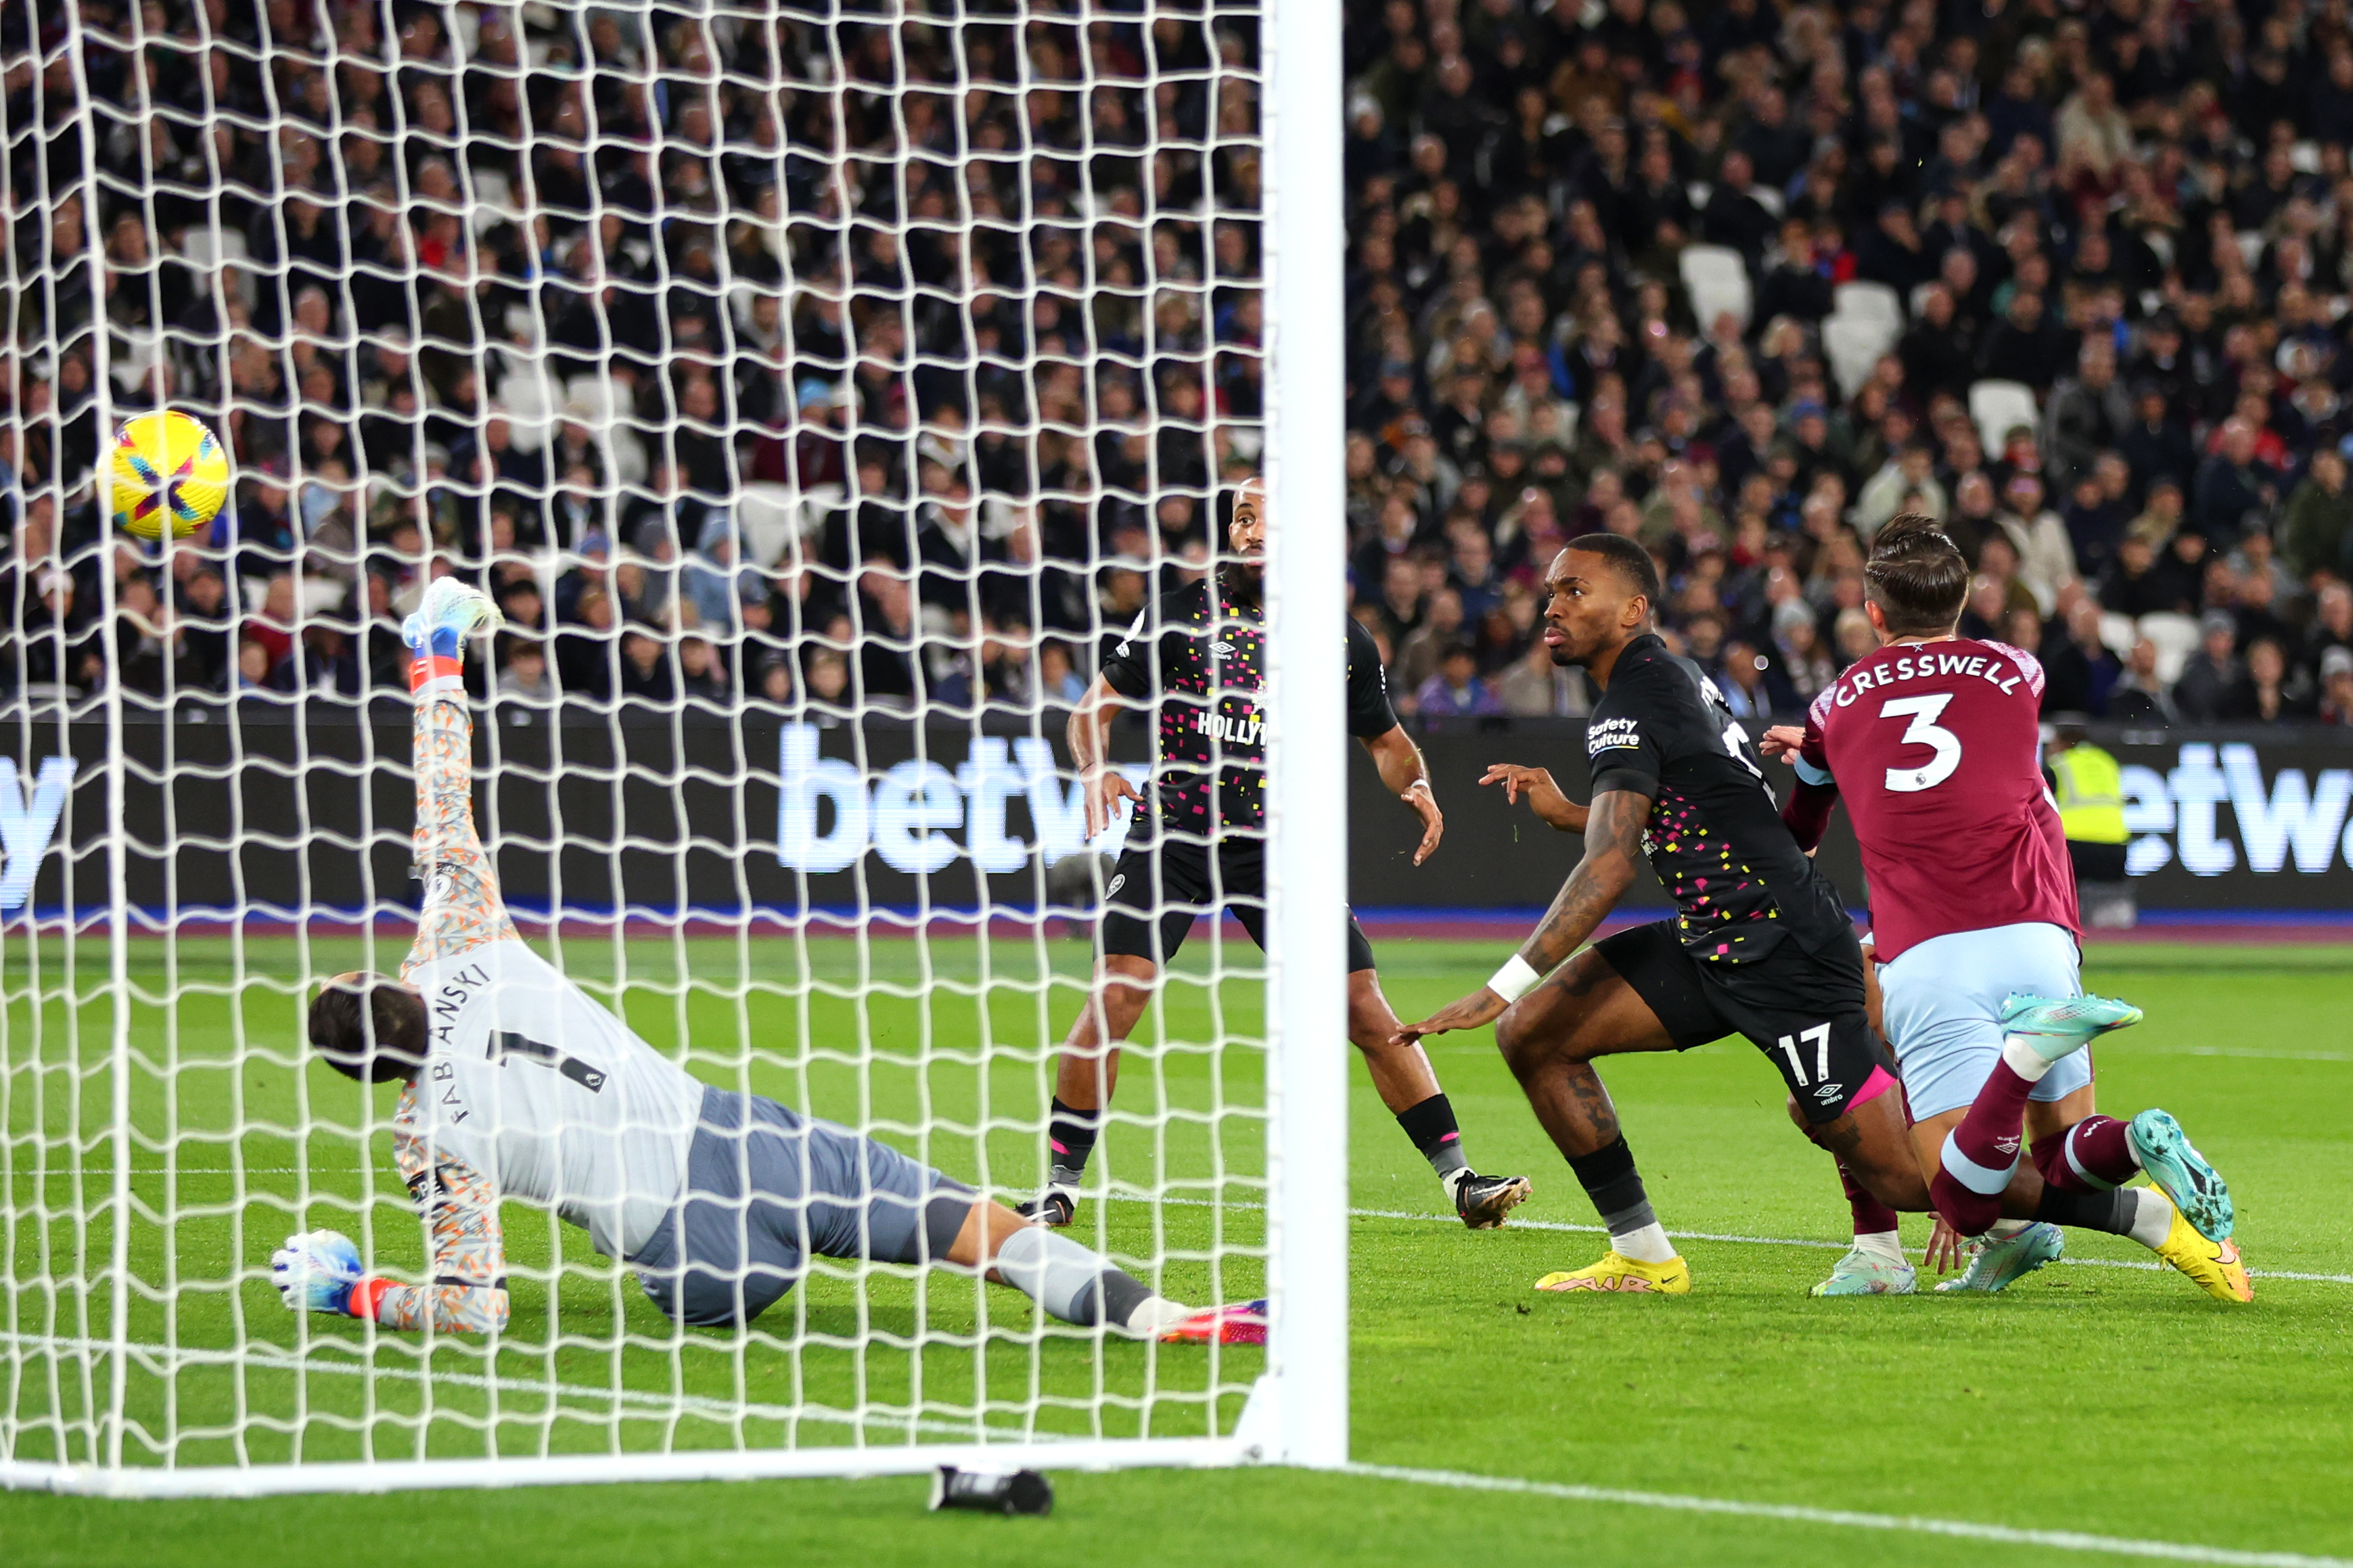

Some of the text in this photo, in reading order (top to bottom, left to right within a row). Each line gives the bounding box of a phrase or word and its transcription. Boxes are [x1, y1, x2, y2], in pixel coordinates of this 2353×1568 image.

[1835, 653, 2021, 708] CRESSWELL
[1588, 718, 1638, 740] Safety
[1589, 733, 1640, 754] Culture
[1879, 693, 1962, 792] 3
[485, 1029, 608, 1094] 1
[1778, 1021, 1831, 1087] 17
[1820, 1094, 1844, 1106] umbro
